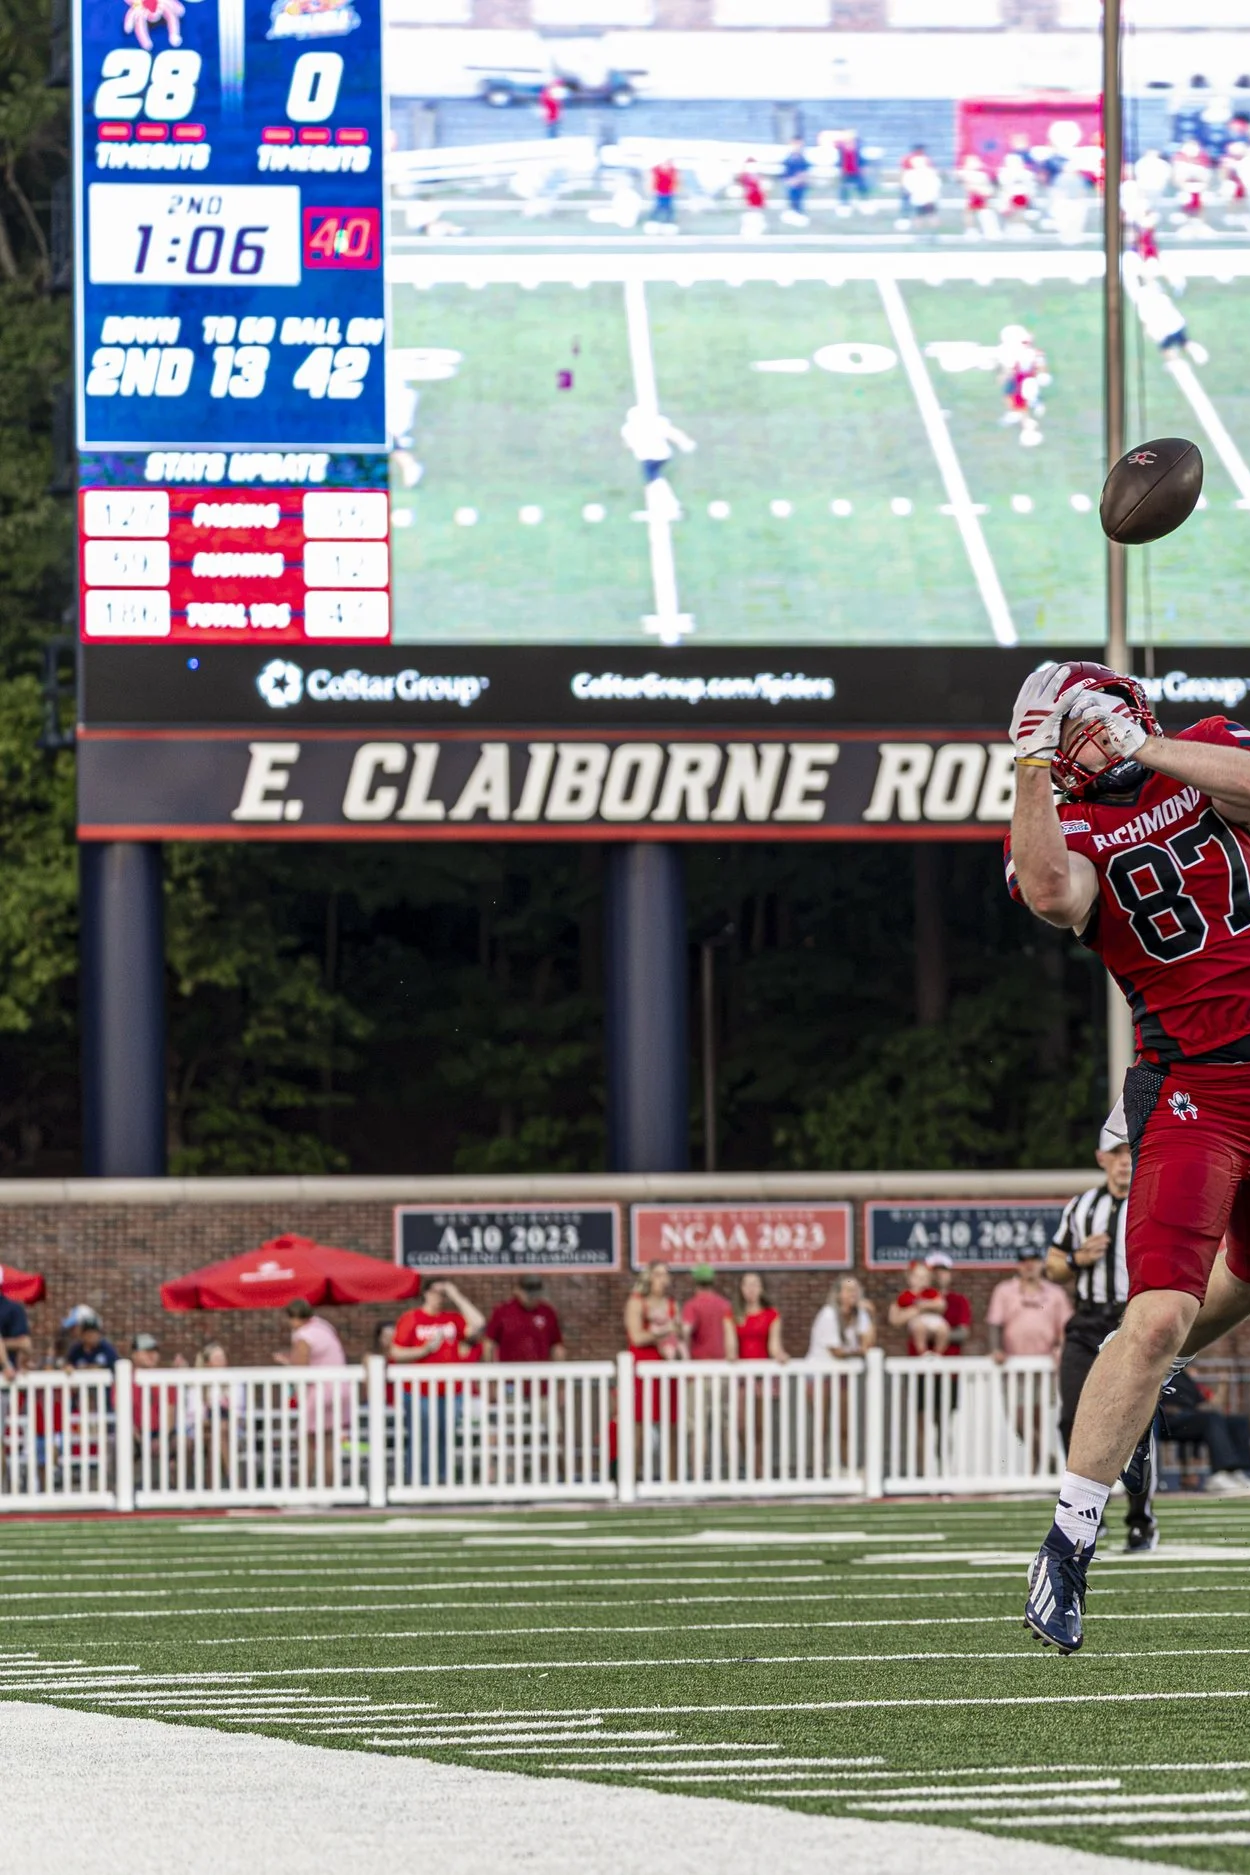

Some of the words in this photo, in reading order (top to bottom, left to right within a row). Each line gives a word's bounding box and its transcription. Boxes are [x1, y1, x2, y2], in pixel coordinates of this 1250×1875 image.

[94, 49, 202, 120] 28
[286, 52, 344, 122] 0
[168, 195, 222, 215] 2ND
[134, 225, 270, 274] 1:06
[309, 218, 371, 258] 40
[86, 347, 194, 397] 2ND
[210, 346, 270, 398] 13
[292, 347, 370, 399] 42
[232, 742, 301, 821] E.
[342, 742, 840, 821] CLAIBORNE
[863, 743, 1018, 821] ROB
[437, 1224, 503, 1253] A-10
[509, 1224, 580, 1252] 2023
[660, 1222, 750, 1251] NCAA
[756, 1222, 826, 1251] 2023
[907, 1221, 971, 1248] A-10
[978, 1219, 1047, 1248] 2024
